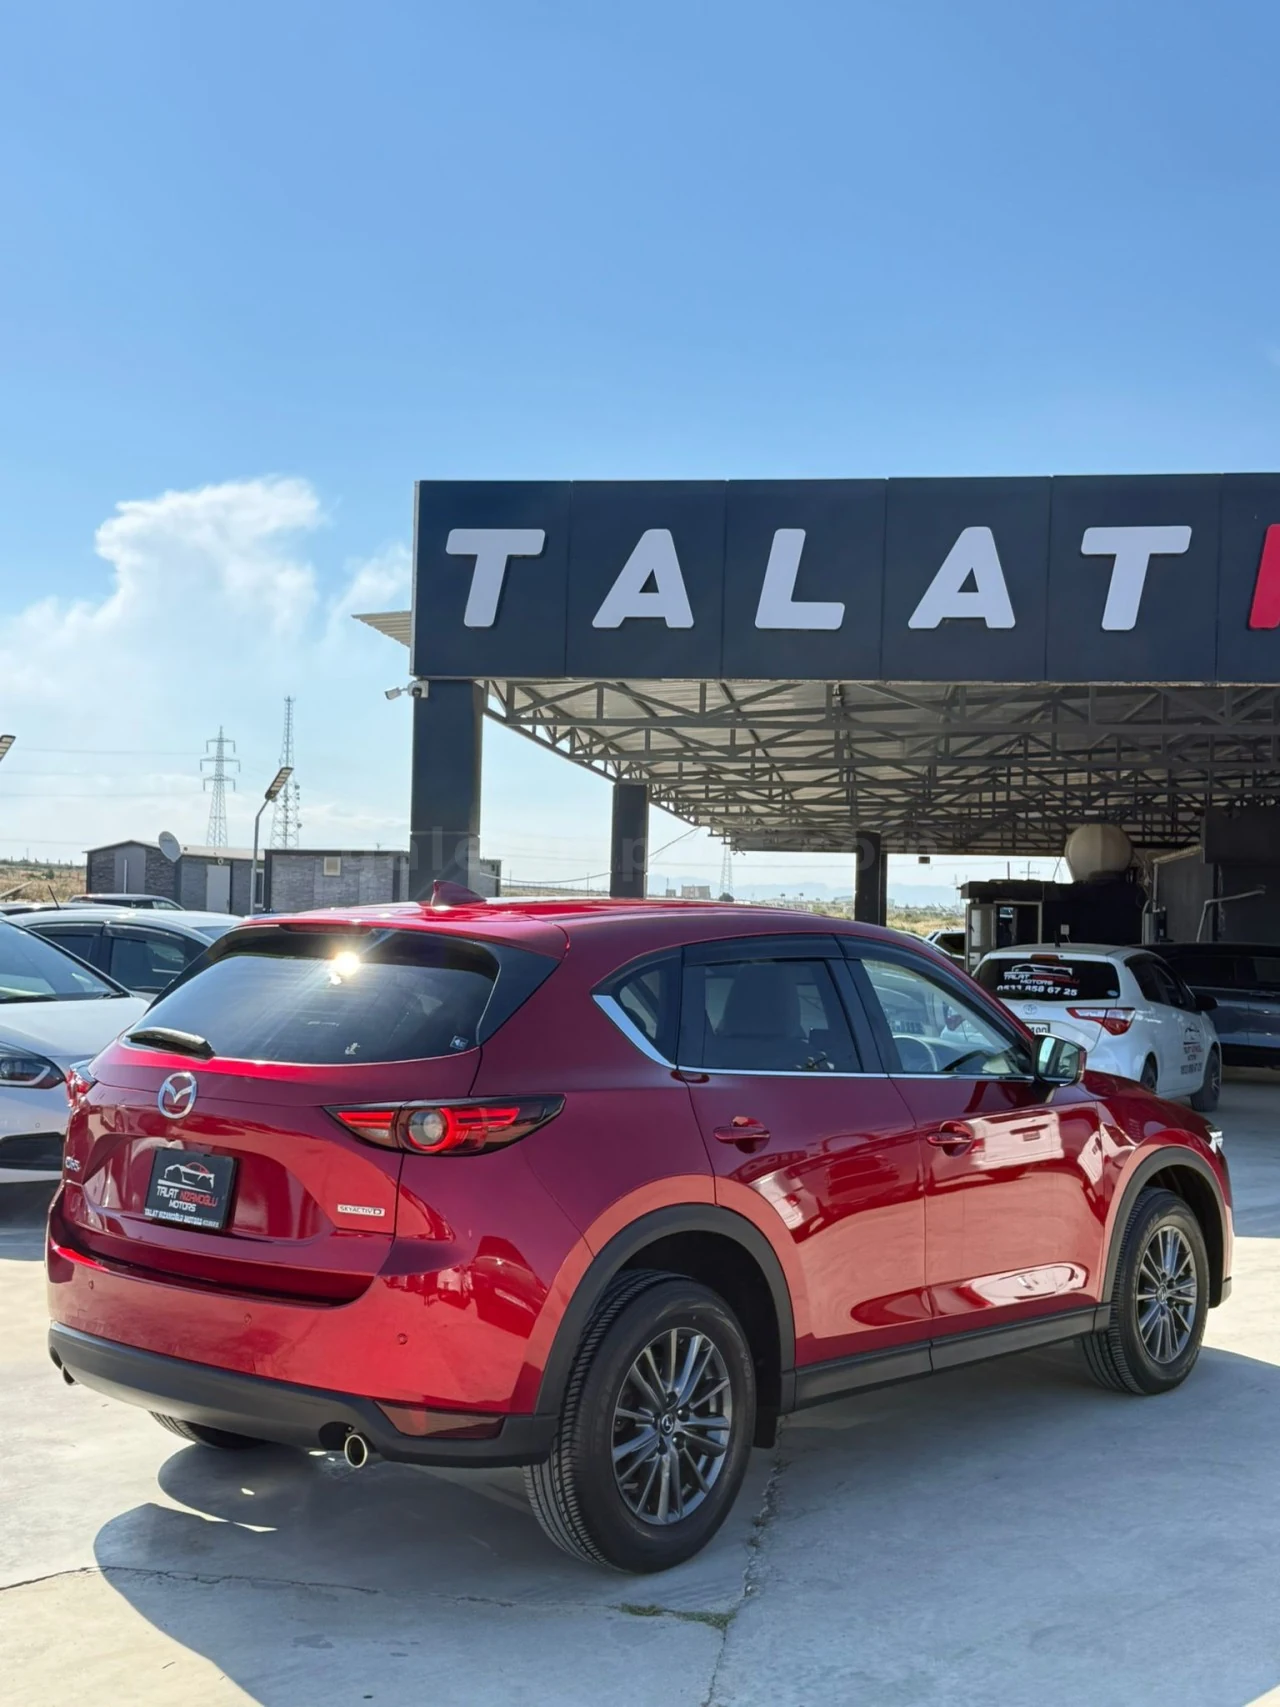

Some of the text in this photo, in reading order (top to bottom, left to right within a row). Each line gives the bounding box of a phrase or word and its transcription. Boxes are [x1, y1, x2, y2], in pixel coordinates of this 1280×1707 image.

[445, 526, 1192, 631] TALAT
[1047, 986, 1062, 994] 67
[1063, 988, 1078, 996] 25
[156, 1185, 180, 1199] TALAT
[168, 1199, 197, 1212] MOTORS
